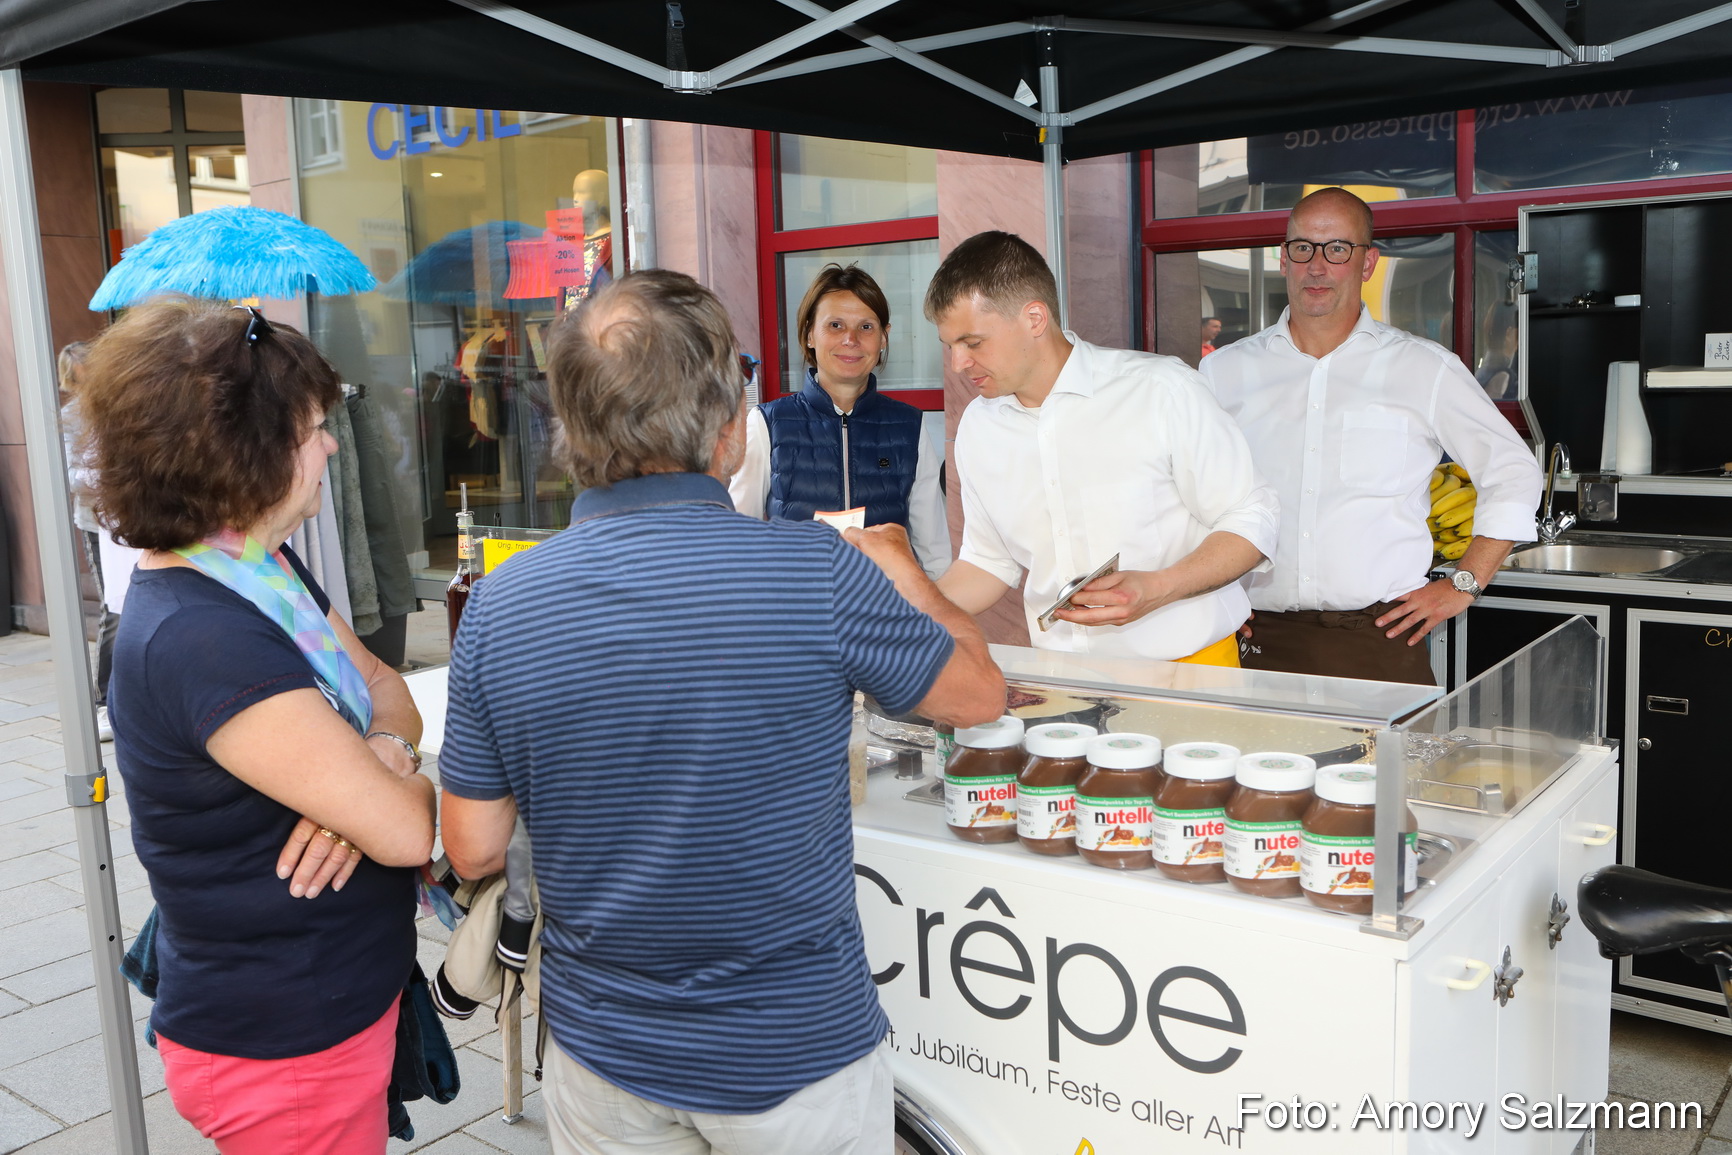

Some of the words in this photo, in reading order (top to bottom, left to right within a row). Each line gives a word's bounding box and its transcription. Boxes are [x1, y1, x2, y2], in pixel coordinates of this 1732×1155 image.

[367, 102, 521, 160] CECIL
[555, 250, 575, 260] -20%
[968, 783, 1017, 802] nutell
[1048, 796, 1076, 812] nut
[1183, 820, 1225, 837] nute
[1255, 834, 1301, 850] nute
[1328, 849, 1375, 866] nute
[910, 1032, 1037, 1093] Jubiläum,
[1047, 1069, 1121, 1113] Feste
[1132, 1099, 1194, 1134] aller
